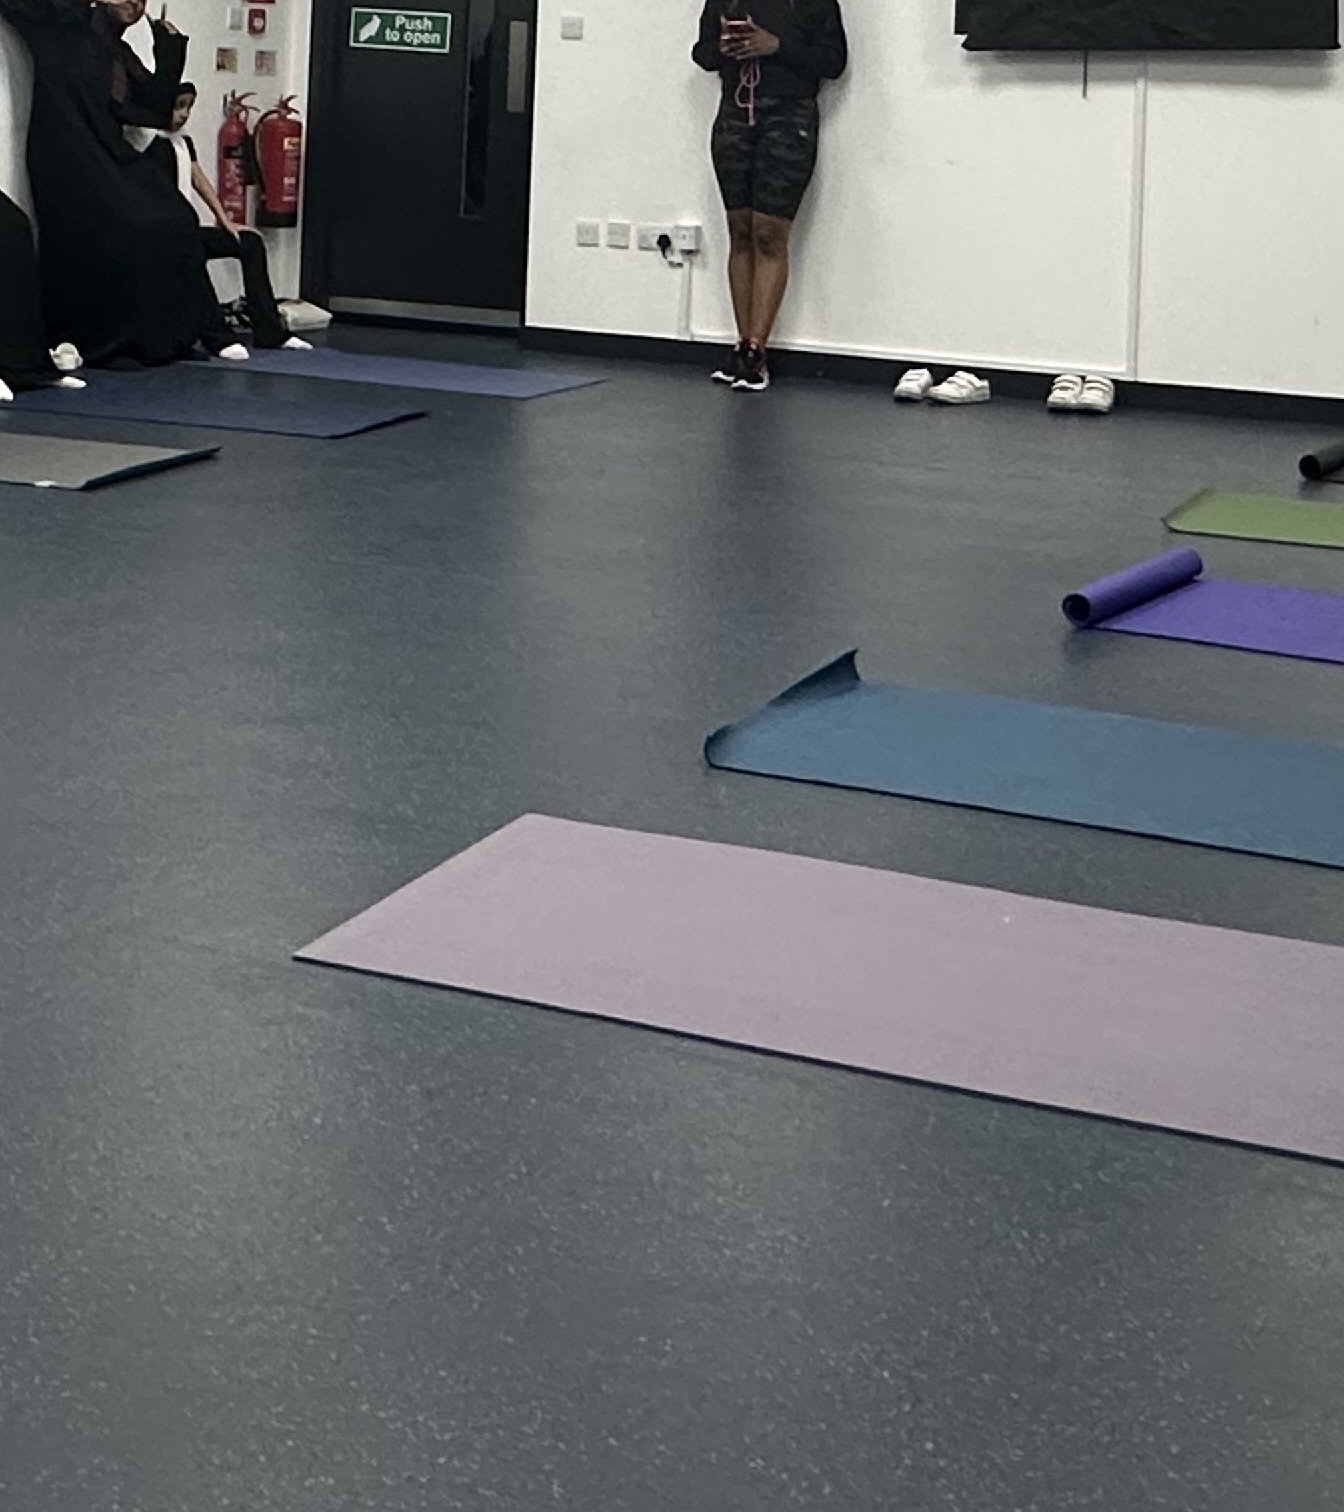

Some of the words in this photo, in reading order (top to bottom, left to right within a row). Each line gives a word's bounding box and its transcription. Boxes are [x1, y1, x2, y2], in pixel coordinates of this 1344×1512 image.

[395, 15, 433, 31] Push
[385, 27, 400, 42] to
[403, 30, 442, 46] open
